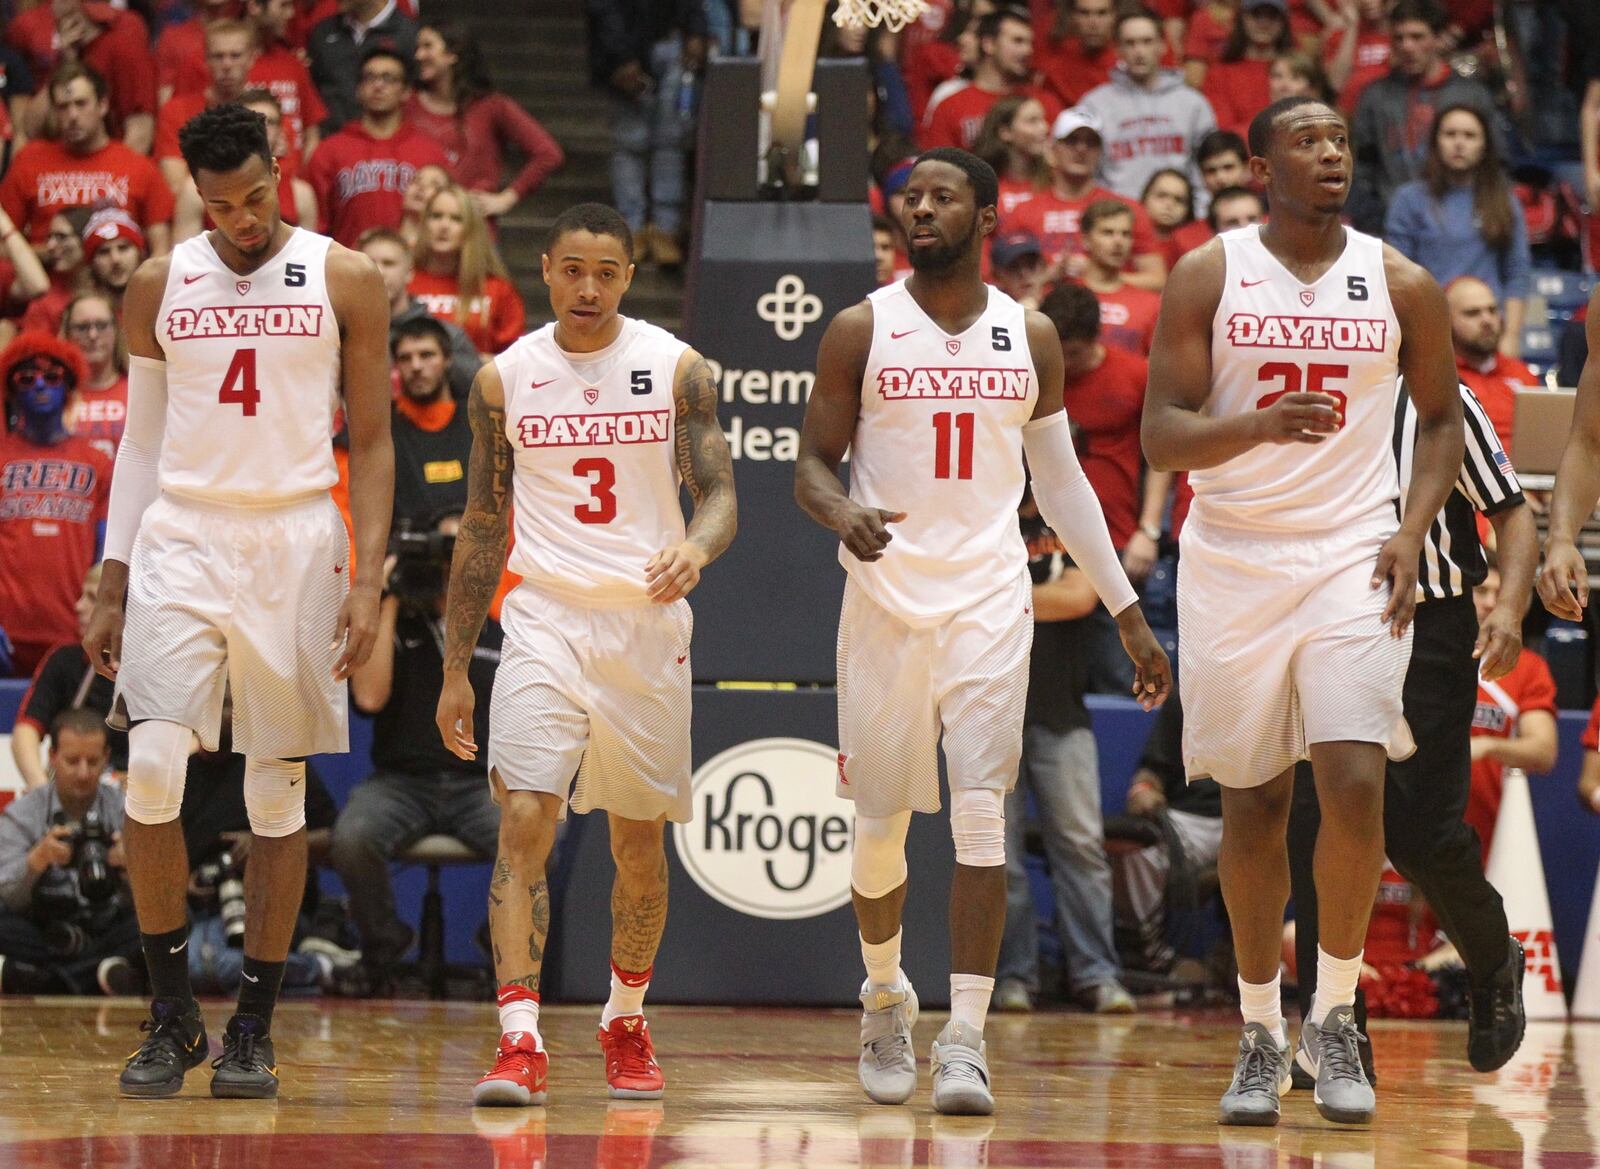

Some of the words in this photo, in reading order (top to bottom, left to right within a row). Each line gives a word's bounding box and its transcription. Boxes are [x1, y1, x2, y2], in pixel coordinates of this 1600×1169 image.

[284, 264, 306, 287] 5
[1347, 277, 1369, 301] 5
[168, 305, 322, 339] DAYTON
[991, 326, 1012, 352] 5
[1228, 313, 1387, 353] DAYTON
[218, 348, 261, 417] 4
[630, 370, 652, 396] 5
[879, 368, 1029, 401] DAYTON
[518, 409, 670, 448] DAYTON
[932, 411, 975, 480] 11
[3, 460, 96, 496] RED
[572, 457, 618, 525] 3
[704, 772, 856, 891] Kroge
